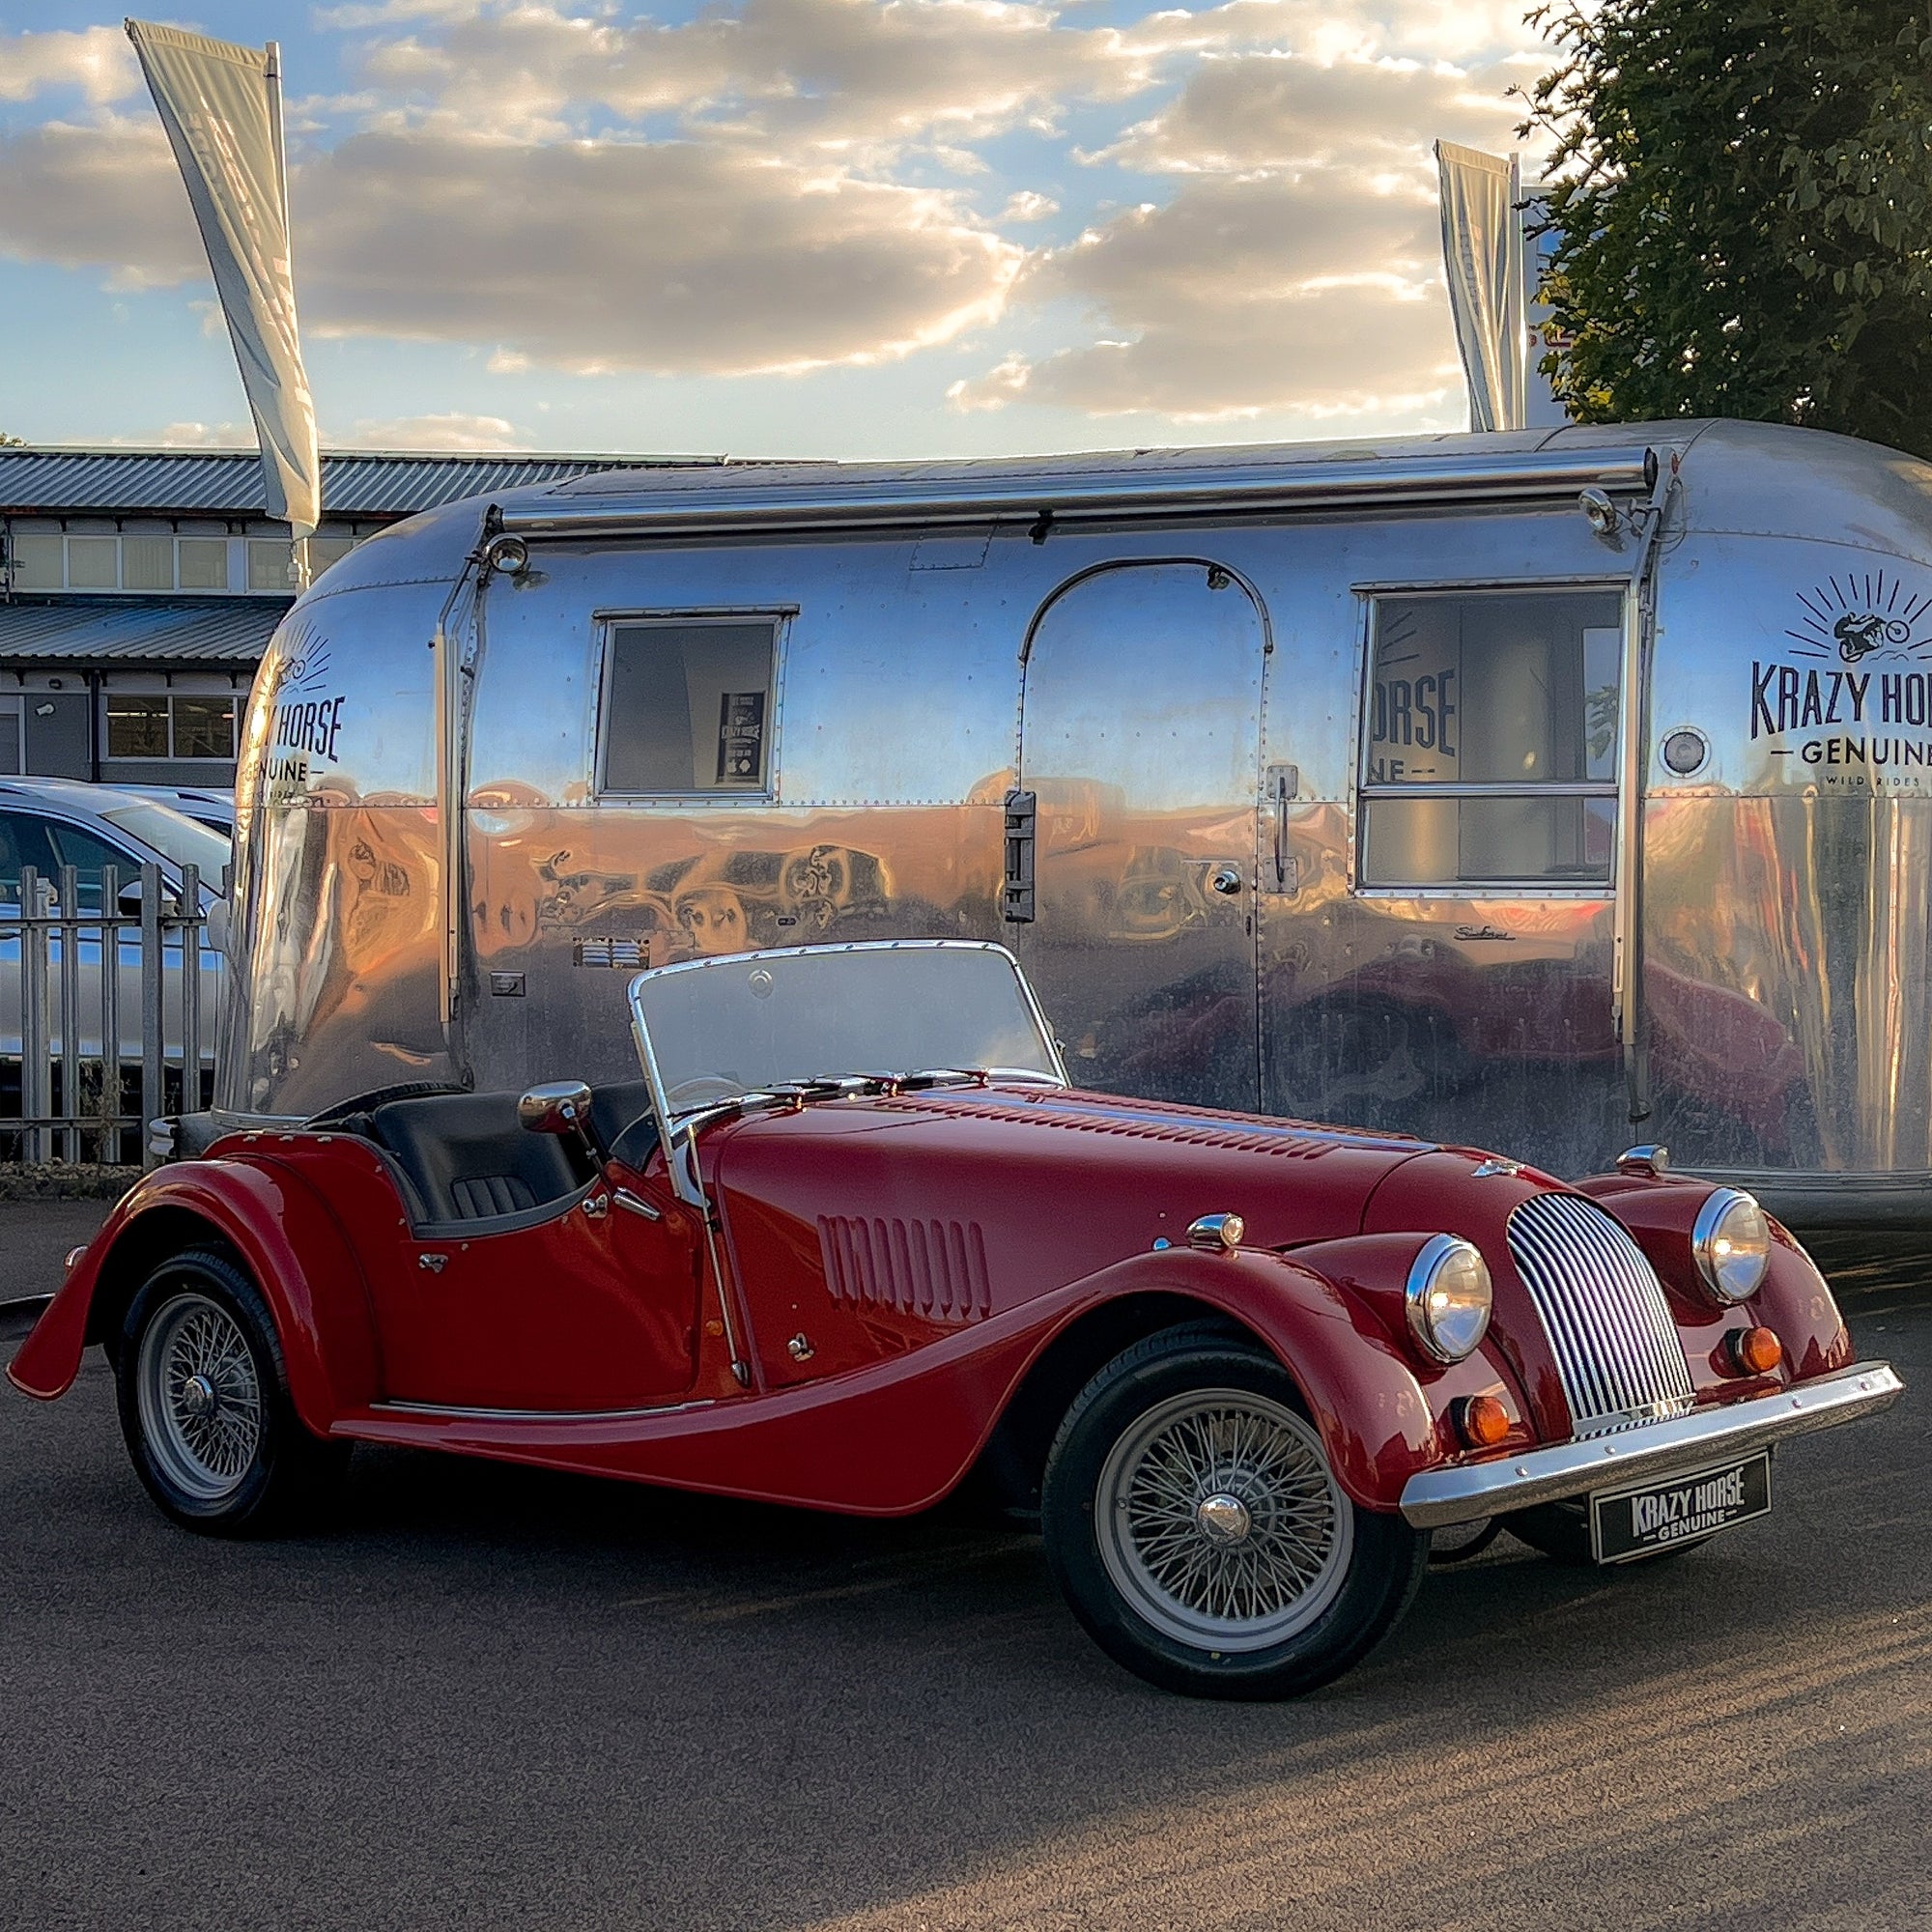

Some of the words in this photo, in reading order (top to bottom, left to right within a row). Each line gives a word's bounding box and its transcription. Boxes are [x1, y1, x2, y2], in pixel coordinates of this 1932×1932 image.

[276, 696, 346, 763] HORSE
[1750, 661, 1870, 741] KRAZY
[1882, 673, 1932, 727] HO
[1826, 776, 1864, 785] WILD
[1876, 777, 1919, 786] RIDES
[1632, 1489, 1692, 1538] KRAZY
[1695, 1466, 1745, 1513] HORSE
[1658, 1509, 1725, 1540] GENUINE
